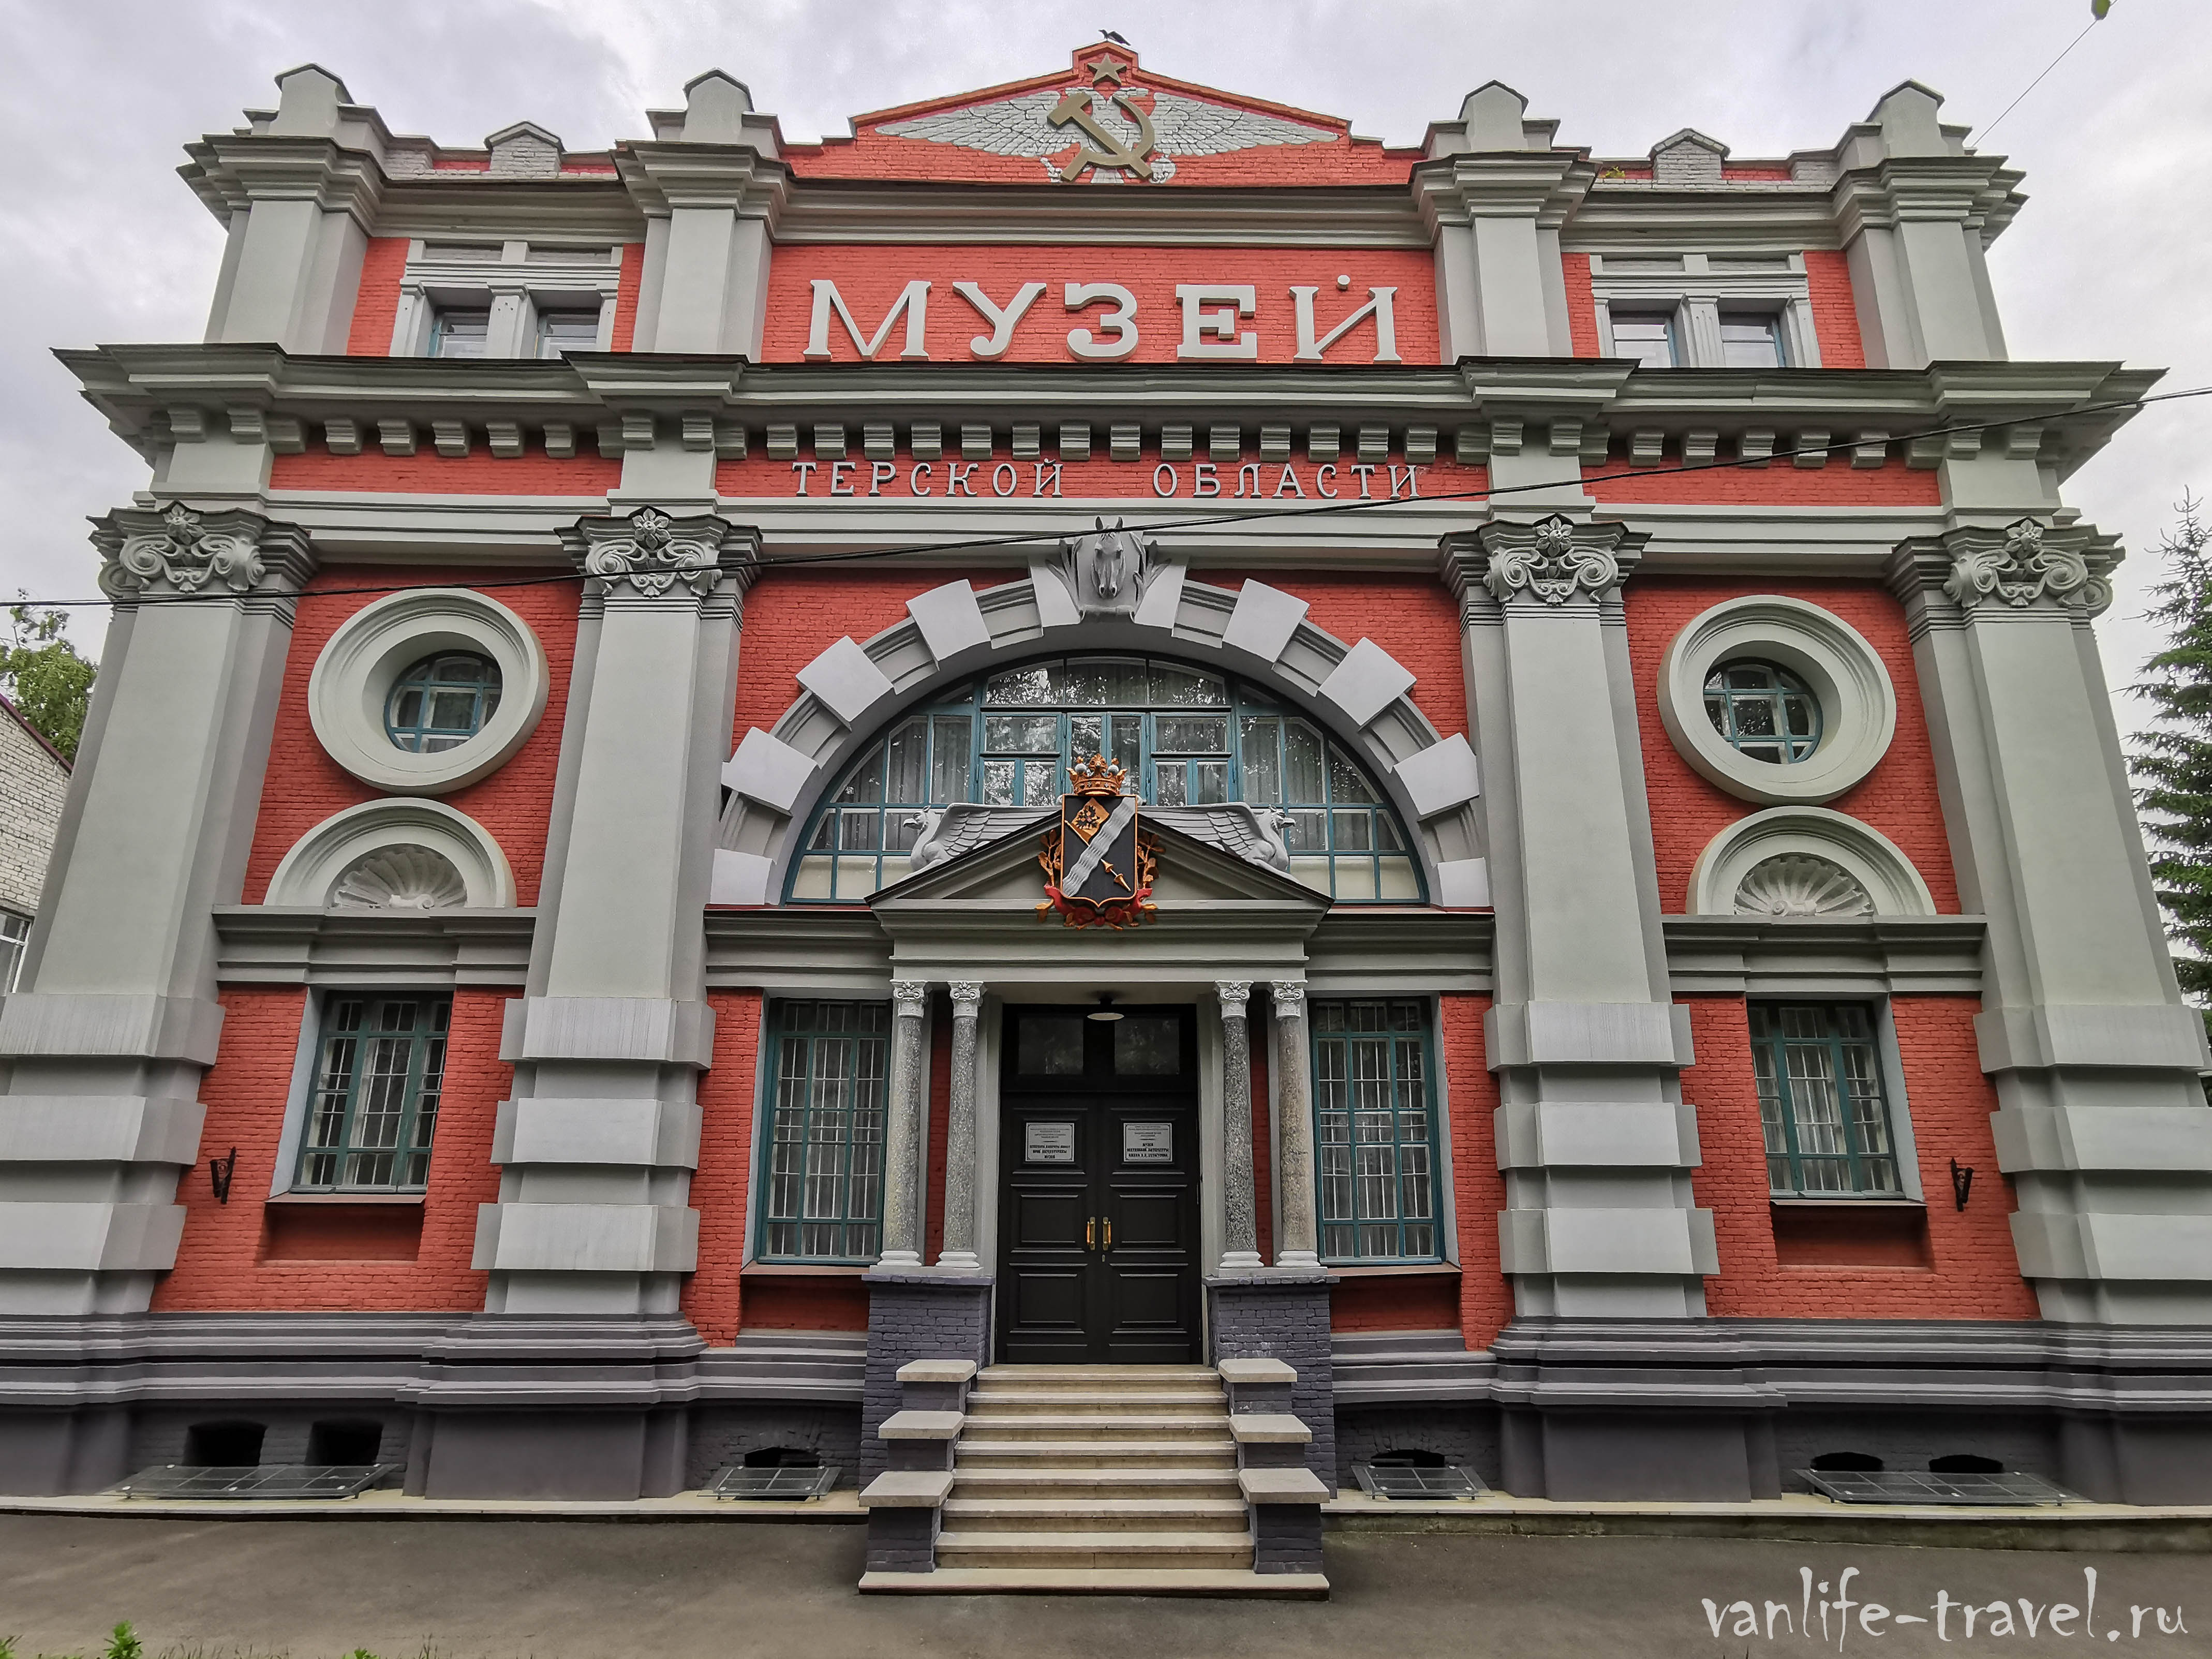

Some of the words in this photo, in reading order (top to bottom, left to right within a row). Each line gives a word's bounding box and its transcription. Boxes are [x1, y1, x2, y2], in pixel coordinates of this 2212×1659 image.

[802, 274, 1403, 364] МУЗЕЙ
[792, 457, 1064, 498] ТЕРСКОЙ
[1152, 462, 1420, 500] ОБЛАСТИ
